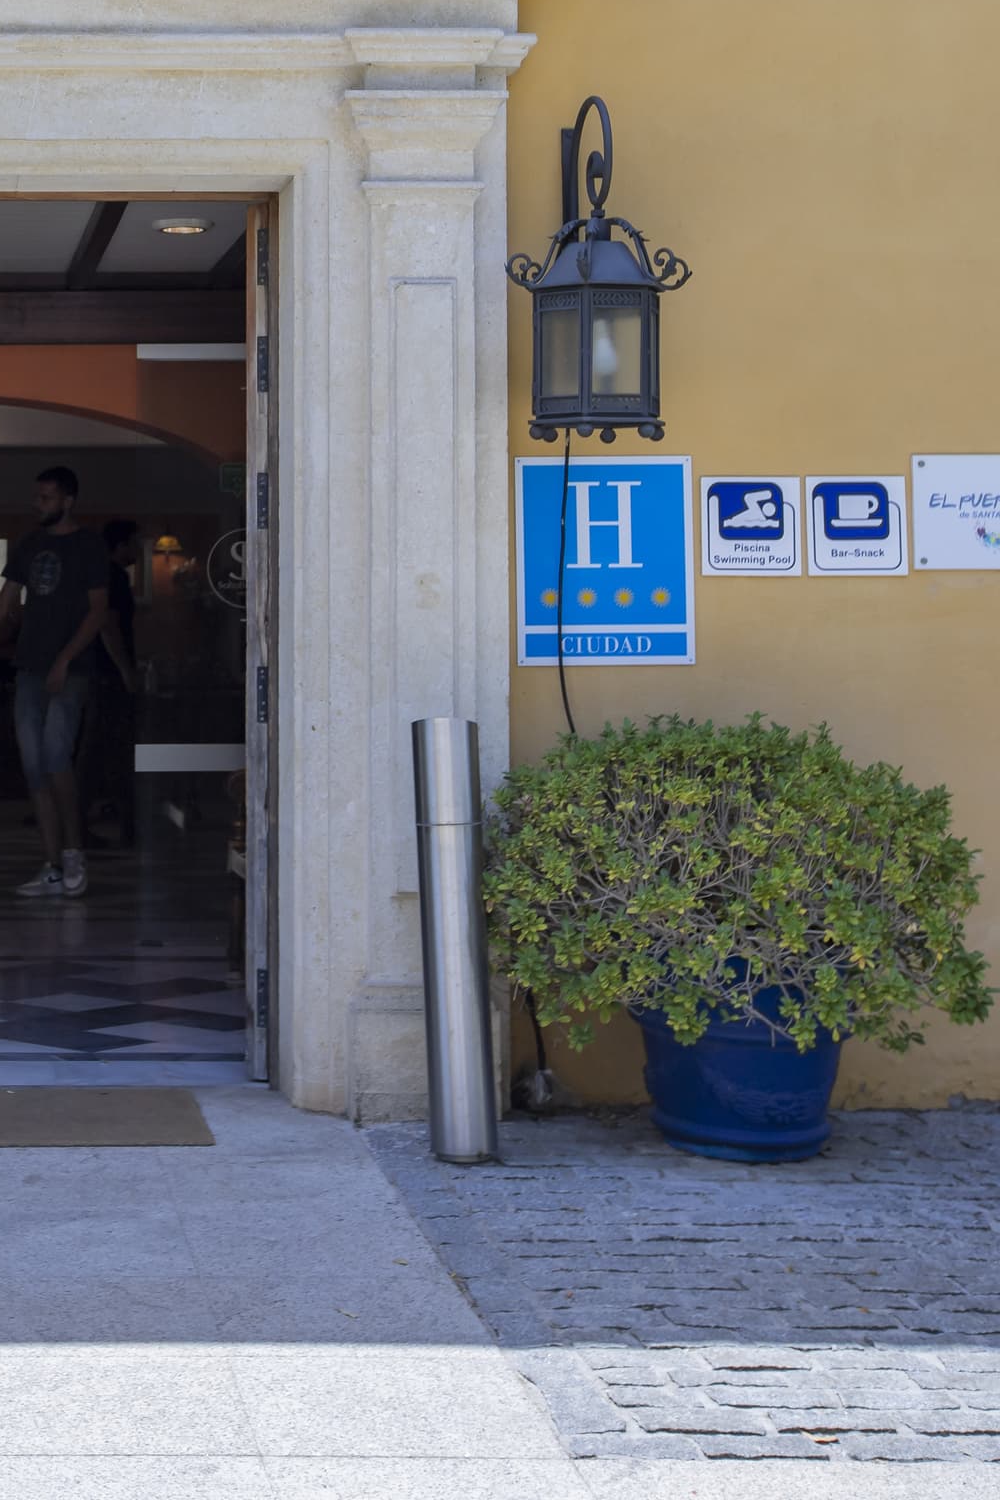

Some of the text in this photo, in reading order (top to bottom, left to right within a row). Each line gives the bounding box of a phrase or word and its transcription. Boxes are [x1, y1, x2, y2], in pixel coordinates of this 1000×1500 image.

[929, 493, 957, 508] EL
[566, 480, 643, 569] H
[734, 543, 770, 553] Piscina
[713, 555, 791, 565] Swimming Pool
[561, 636, 652, 654] CIUDAD
